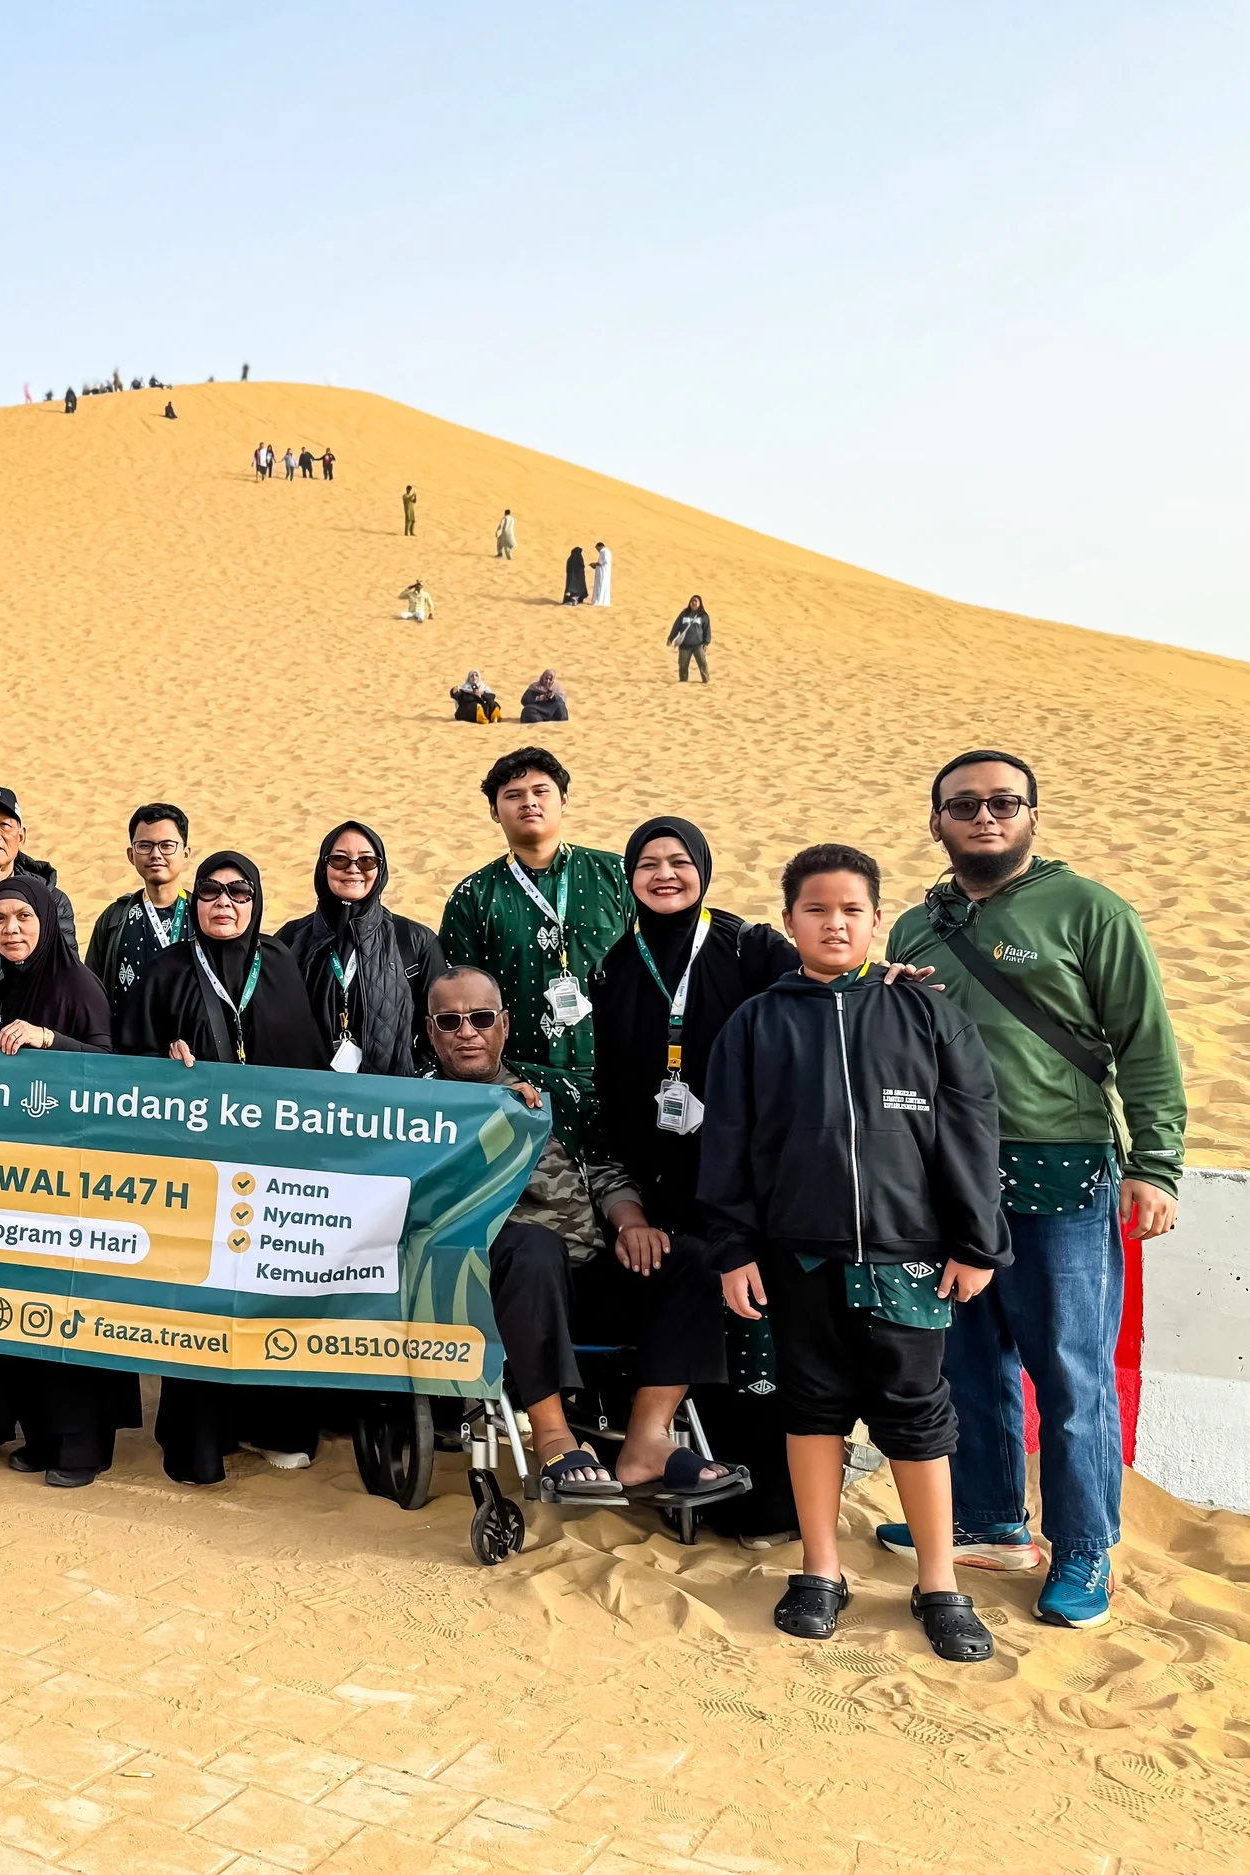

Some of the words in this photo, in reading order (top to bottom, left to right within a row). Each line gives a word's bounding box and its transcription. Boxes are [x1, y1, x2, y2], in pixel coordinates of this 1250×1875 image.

[1005, 944, 1038, 960] faaza
[70, 1087, 208, 1131] undang
[221, 1094, 261, 1127] ke
[275, 1100, 457, 1144] Baitullah
[80, 1172, 157, 1205] 1447
[166, 1182, 188, 1209] H
[266, 1179, 329, 1198] Aman
[264, 1207, 351, 1229] Nyaman
[70, 1229, 82, 1247] 9
[90, 1231, 136, 1253] Hari
[260, 1235, 324, 1255] Penuh
[257, 1263, 384, 1283] Kemudahan
[95, 1317, 228, 1353] faaza.travel
